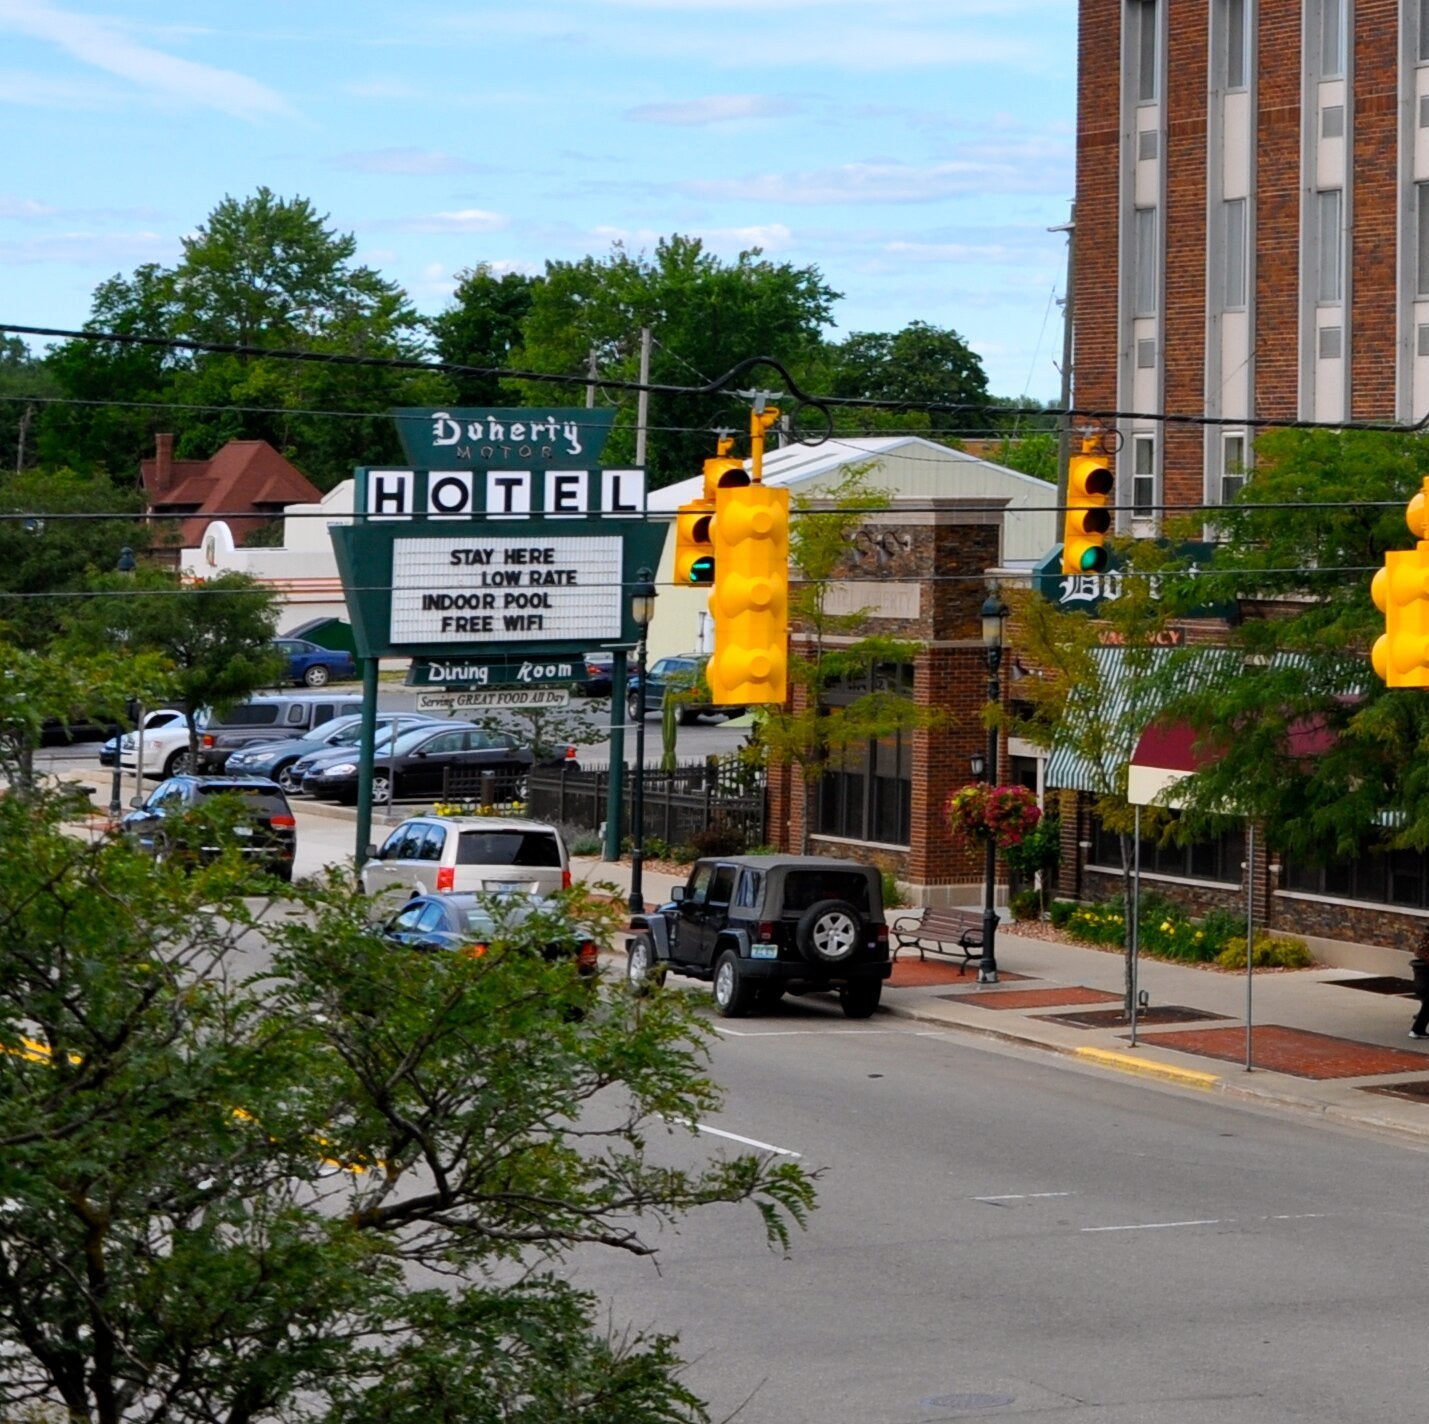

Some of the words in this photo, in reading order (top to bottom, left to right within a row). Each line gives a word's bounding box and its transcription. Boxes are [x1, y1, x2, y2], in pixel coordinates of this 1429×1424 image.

[431, 412, 583, 455] Doherty
[457, 445, 551, 459] MOTOR
[375, 476, 637, 514] HOTEL
[450, 548, 494, 566] STAY
[504, 548, 555, 565] HERE
[481, 570, 522, 586] LOW
[529, 569, 578, 585] RATE
[422, 593, 496, 611] INDOOR
[503, 592, 553, 609] POOL
[441, 615, 494, 633] FREE
[503, 614, 543, 631] WIFI
[428, 661, 489, 685] Dining
[516, 661, 572, 682] Room
[420, 694, 454, 708] Serving
[457, 693, 498, 706] GREAT
[498, 692, 529, 705] FOOD
[531, 692, 544, 703] All
[546, 691, 565, 704] Day
